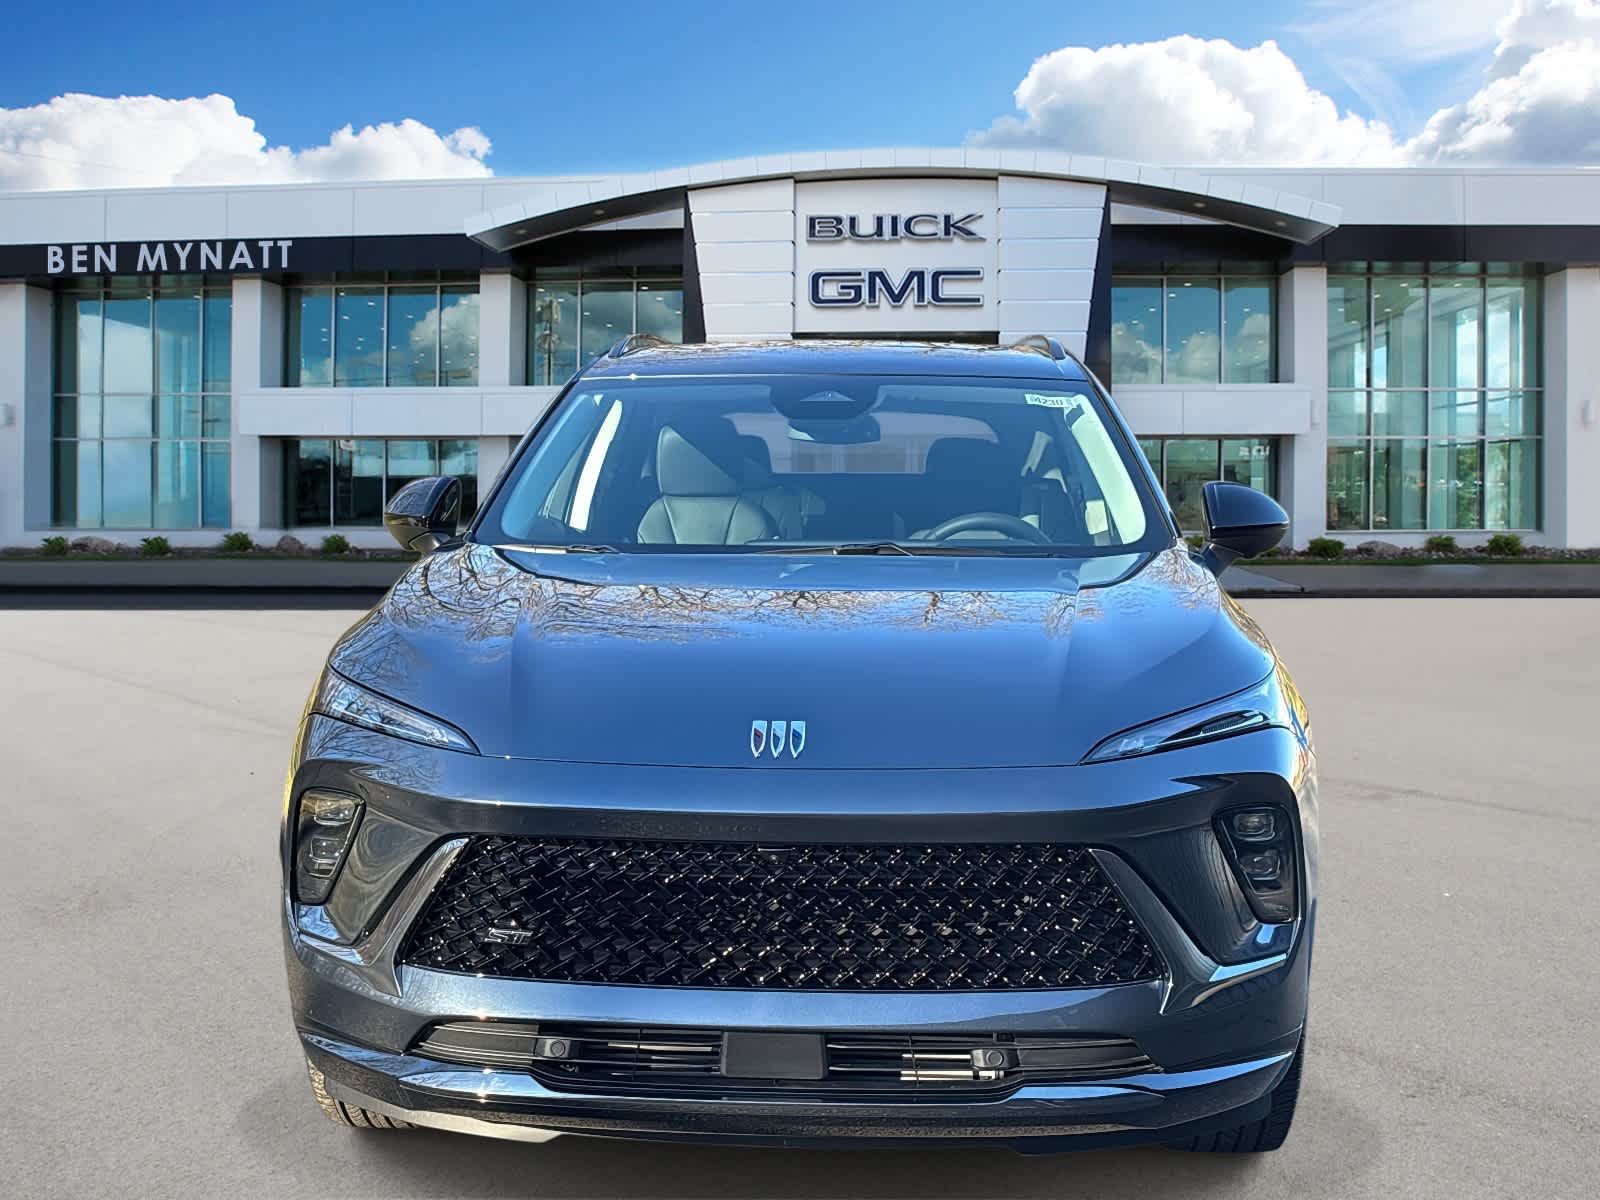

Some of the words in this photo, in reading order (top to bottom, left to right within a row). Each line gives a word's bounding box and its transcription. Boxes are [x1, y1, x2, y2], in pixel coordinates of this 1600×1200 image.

[806, 213, 986, 242] BUICK
[47, 245, 117, 273] BEN
[137, 240, 293, 271] MYNATT
[808, 268, 984, 307] GMC
[484, 928, 533, 945] ST
